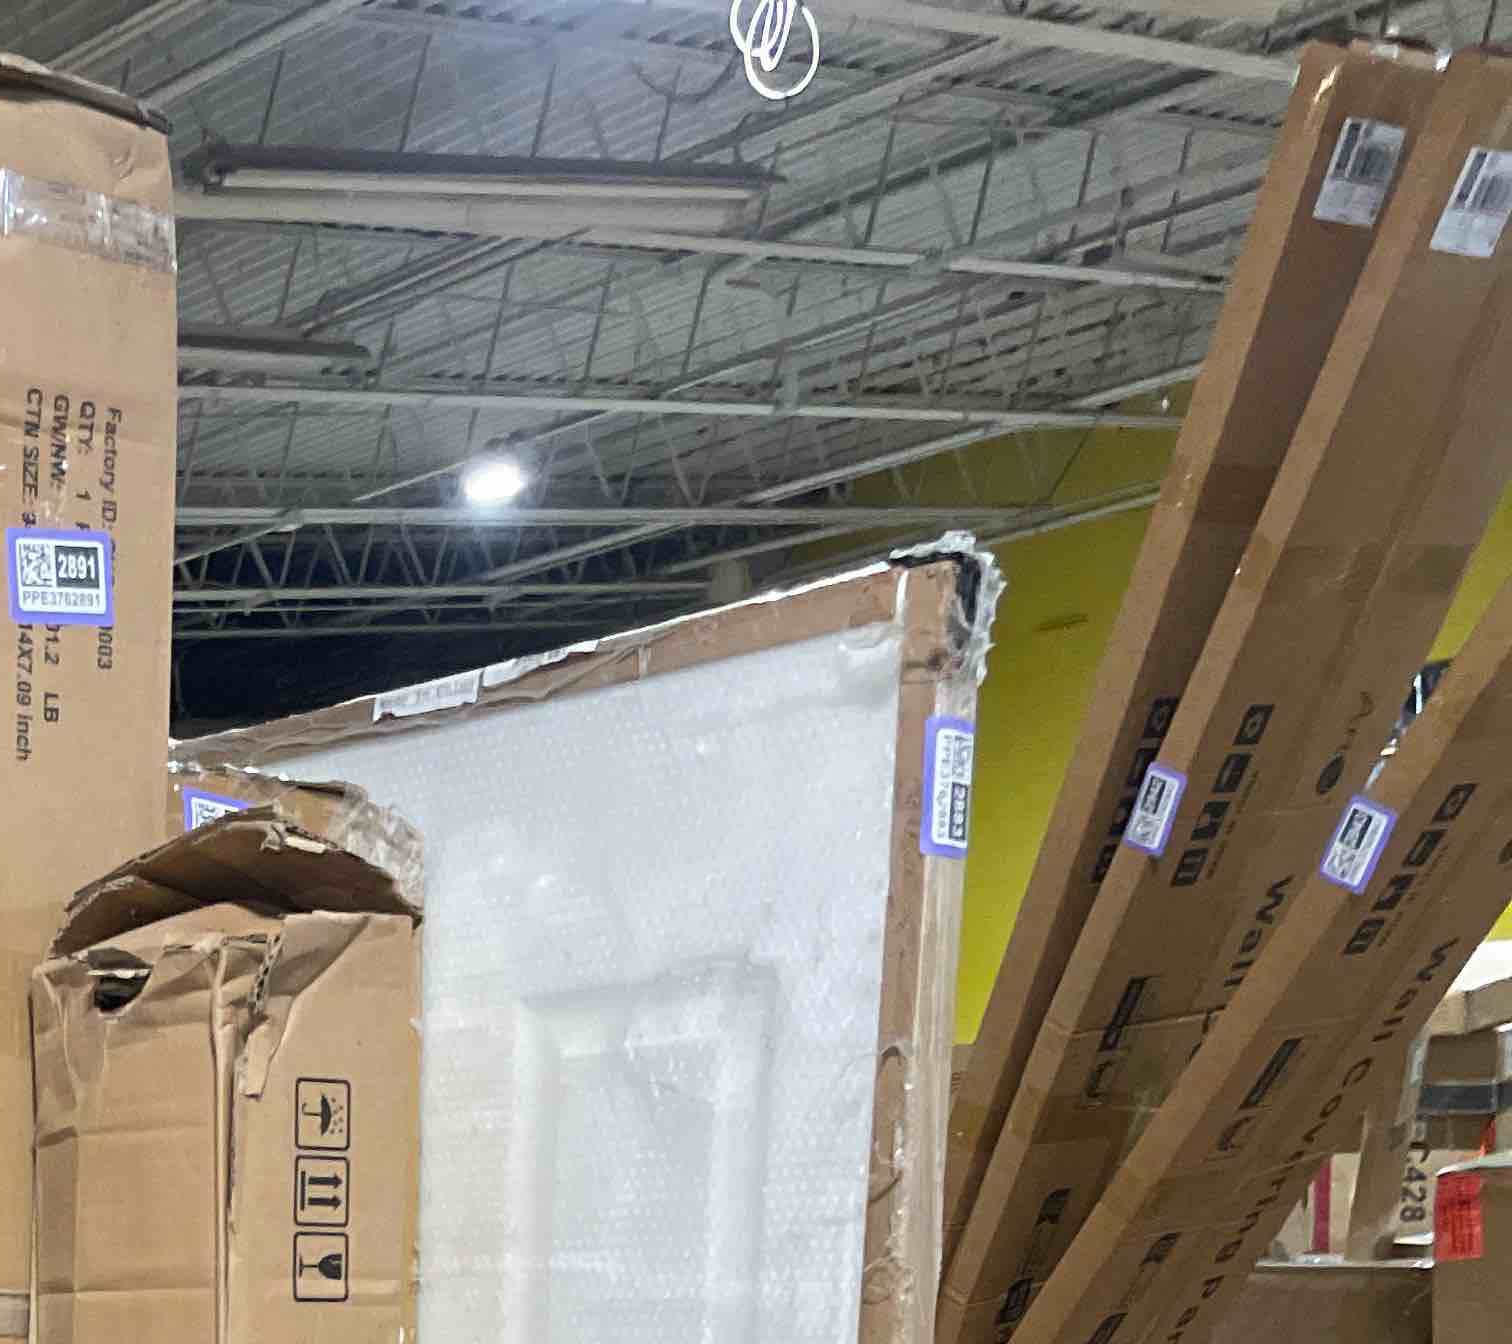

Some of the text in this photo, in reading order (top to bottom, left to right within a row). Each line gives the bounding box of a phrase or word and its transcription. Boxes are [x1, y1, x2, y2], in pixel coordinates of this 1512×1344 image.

[24, 388, 43, 439] CTN
[77, 401, 96, 454] QTY:
[50, 394, 70, 490] GW/NW:
[99, 407, 122, 493] Factory
[56, 552, 97, 582] 2891
[22, 590, 100, 609] PPE3762891
[43, 692, 59, 723] LB
[16, 714, 33, 761] inch
[1371, 936, 1459, 1044] Wall
